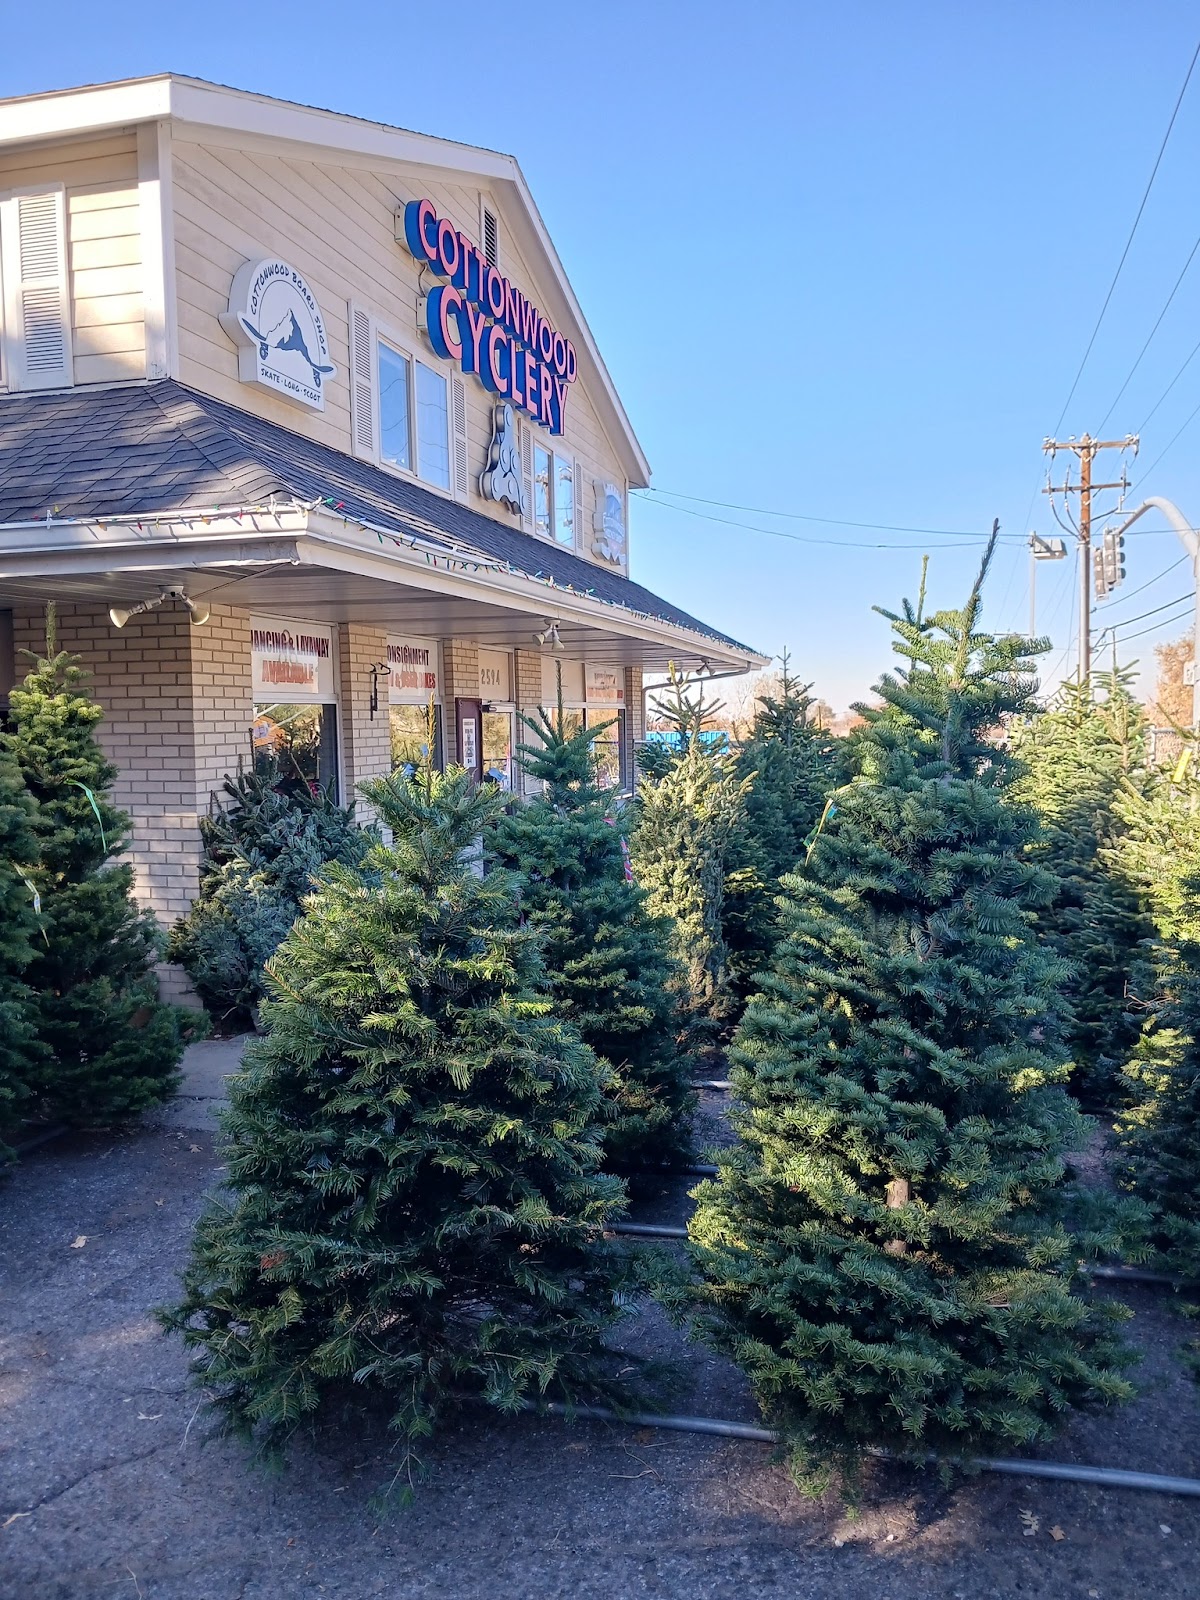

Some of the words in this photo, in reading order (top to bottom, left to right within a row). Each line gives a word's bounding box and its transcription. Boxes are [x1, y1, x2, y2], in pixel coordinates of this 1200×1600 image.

[250, 263, 290, 315] COTTONWOOD
[292, 272, 315, 311] BOARD
[314, 315, 327, 355] SHOP
[416, 198, 578, 384] COTTONWOOD
[437, 284, 569, 437] CYCLERY
[261, 367, 281, 383] SKATE
[283, 379, 300, 393] LONG
[303, 388, 321, 403] SCOOT
[296, 633, 330, 658] LAYAWAY
[386, 644, 430, 666] ONSIGNMENT
[480, 668, 501, 686] 2594
